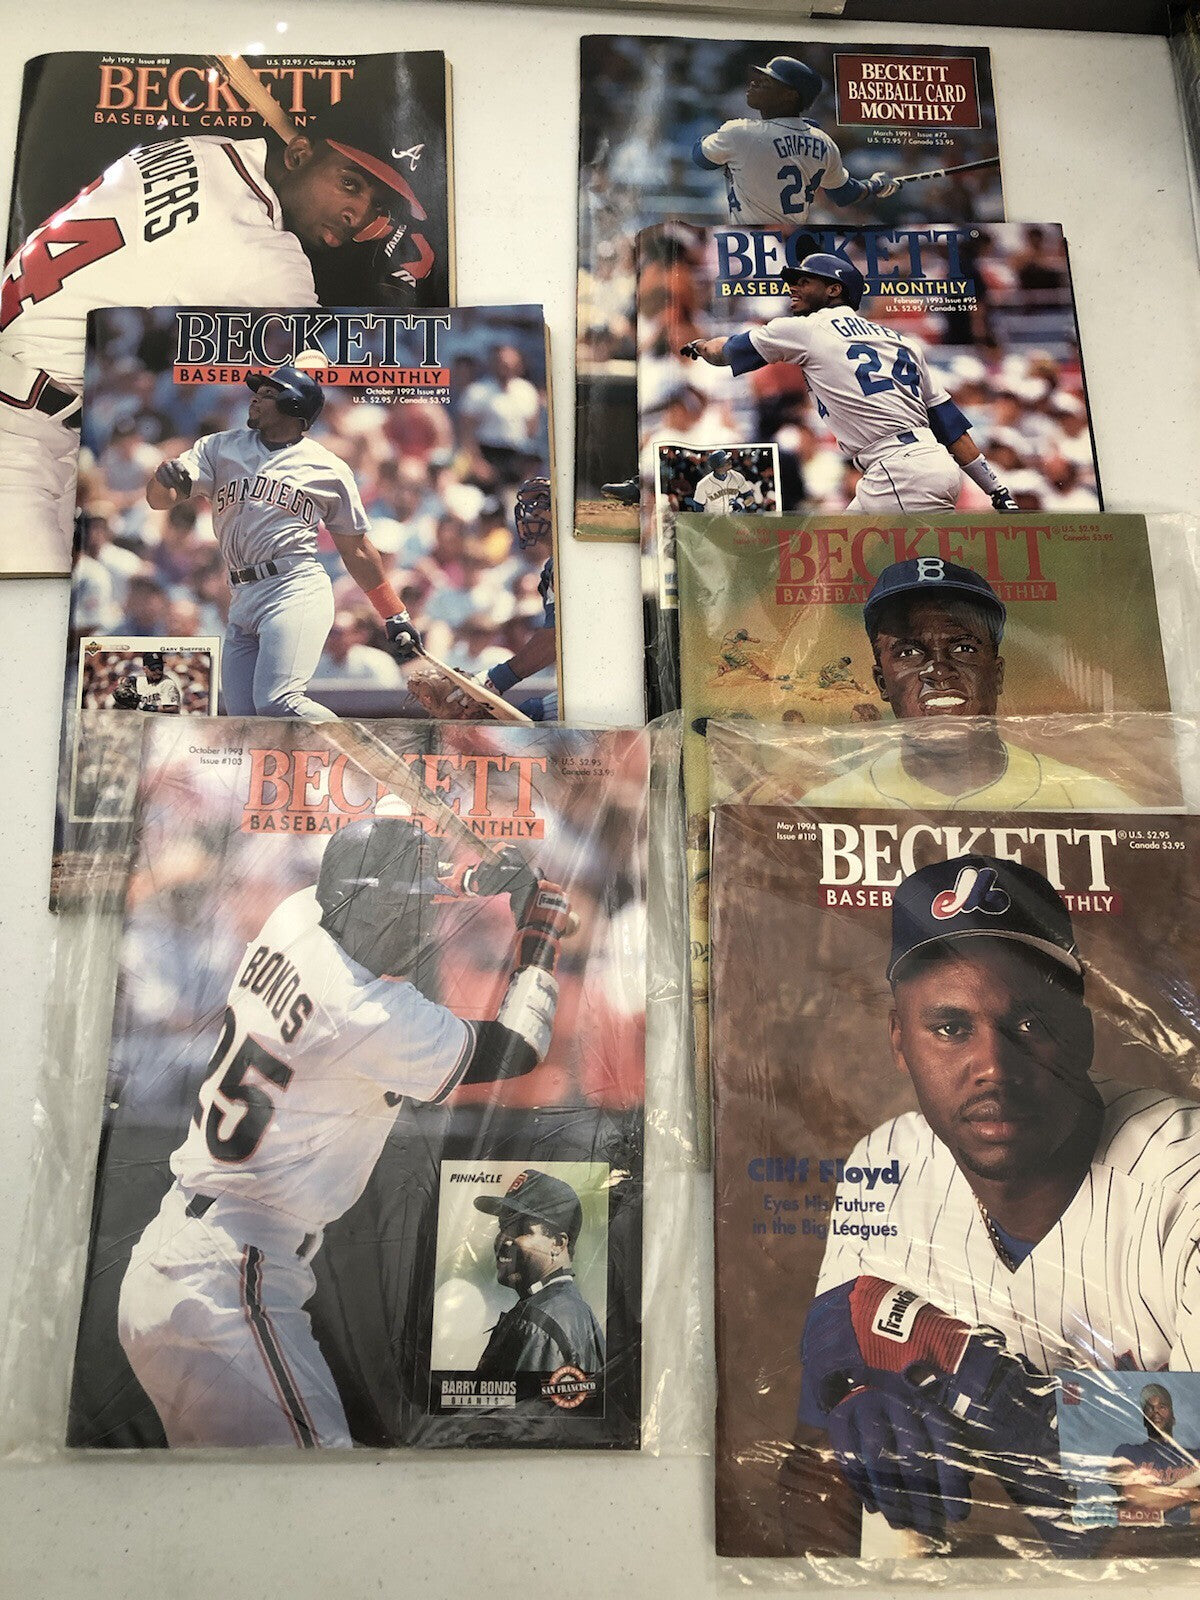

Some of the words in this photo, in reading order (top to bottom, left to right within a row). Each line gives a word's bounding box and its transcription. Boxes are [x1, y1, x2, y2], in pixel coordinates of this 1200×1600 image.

[101, 56, 115, 64] July
[861, 63, 949, 82] BECKETT
[847, 81, 922, 101] BASEBALL
[925, 83, 966, 103] CARD
[861, 102, 956, 121] MONTHLY
[94, 111, 190, 128] BASEBALL
[200, 114, 252, 127] CARD
[773, 135, 827, 162] GRIFFEY
[721, 281, 791, 297] BASEBA
[880, 281, 967, 295] MONTHLY
[893, 296, 924, 305] February
[957, 305, 978, 313] $3.95
[173, 312, 452, 369] BECKETT
[180, 369, 272, 383] BASEBA
[349, 370, 442, 384] MONTHLY
[846, 344, 920, 397] 24
[365, 387, 395, 395] October
[352, 396, 368, 404] U.S.
[370, 396, 391, 404] $2.95
[429, 396, 451, 404] $3.95
[217, 477, 251, 514] SAN
[249, 475, 315, 526] DIEGO
[1061, 525, 1076, 533] U.S.
[1078, 525, 1100, 533] $2.95
[1062, 534, 1091, 542] Canada
[1092, 534, 1114, 542] $3.95
[916, 557, 945, 582] B
[783, 588, 868, 603] BASEBAL
[1001, 585, 1050, 599] THLY
[189, 746, 220, 755] October
[223, 747, 243, 756] 1993
[199, 757, 220, 765] Issue
[221, 757, 243, 766] #103
[561, 757, 576, 766] U.S.
[578, 758, 602, 767] $2.95
[561, 767, 591, 776] Canada
[436, 818, 537, 837] NTHLY
[776, 821, 795, 832] May
[796, 821, 817, 831] 1994
[776, 832, 796, 841] Issue
[797, 832, 817, 842] #110
[1128, 830, 1145, 839] U.S.
[1146, 831, 1170, 840] $2.95
[1129, 841, 1160, 850] Canada
[1161, 841, 1186, 850] $3.95
[826, 889, 893, 907] BASEB
[1064, 895, 1114, 912] THLY
[238, 946, 314, 1044] BONDS
[450, 1171, 503, 1183] PINNACLE
[747, 1157, 810, 1182] Cliff
[819, 1158, 901, 1190] Floyd
[763, 1194, 799, 1215] Eyes
[804, 1194, 830, 1212] His
[835, 1195, 886, 1212] Future
[752, 1218, 767, 1235] in
[772, 1216, 797, 1235] the
[802, 1217, 829, 1240] Big
[832, 1219, 898, 1241] Leagues
[441, 1380, 477, 1395] BARRY
[480, 1380, 517, 1395] BONDS
[541, 1385, 556, 1395] SAN
[557, 1381, 596, 1394] FRANCISCO
[1119, 1510, 1160, 1521] FLOYD
